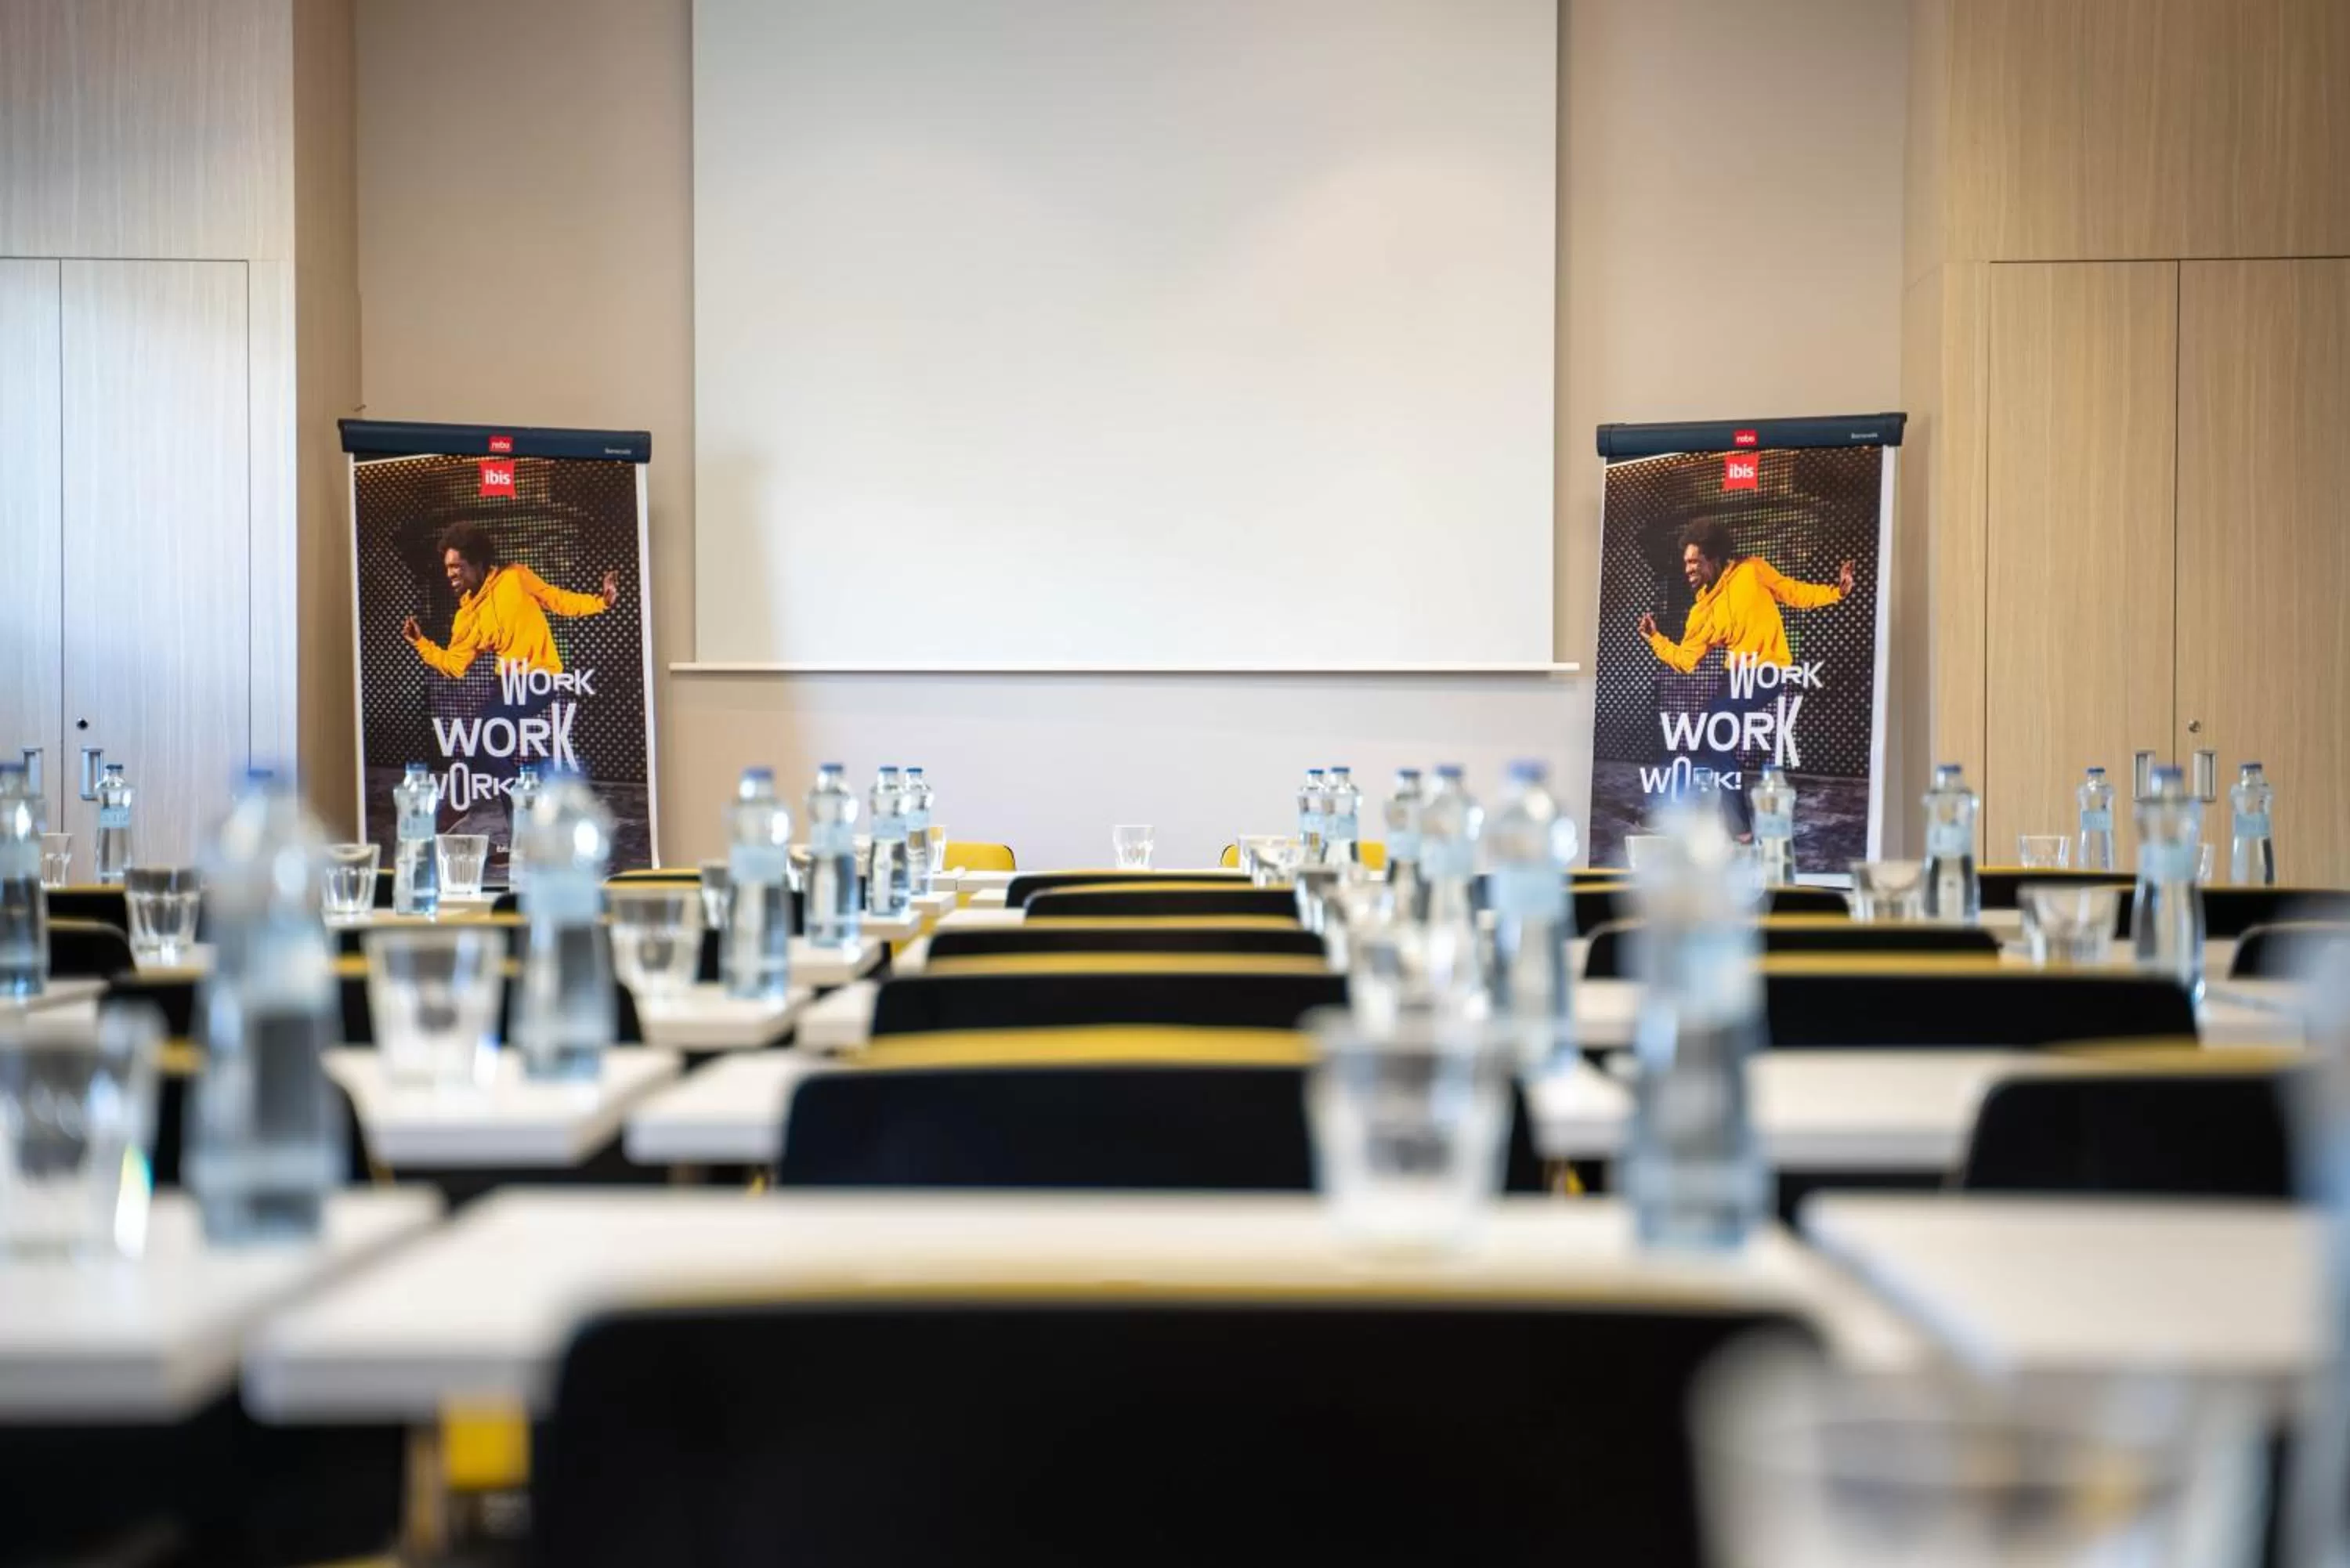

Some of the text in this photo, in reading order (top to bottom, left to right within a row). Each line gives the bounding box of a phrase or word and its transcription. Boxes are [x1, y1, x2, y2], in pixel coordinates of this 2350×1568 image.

[485, 468, 512, 485] ibis
[1729, 463, 1755, 479] ibis
[500, 657, 596, 706] WORK
[1728, 651, 1826, 699] WORK
[432, 703, 580, 772] WORK
[1659, 695, 1803, 768] WORK
